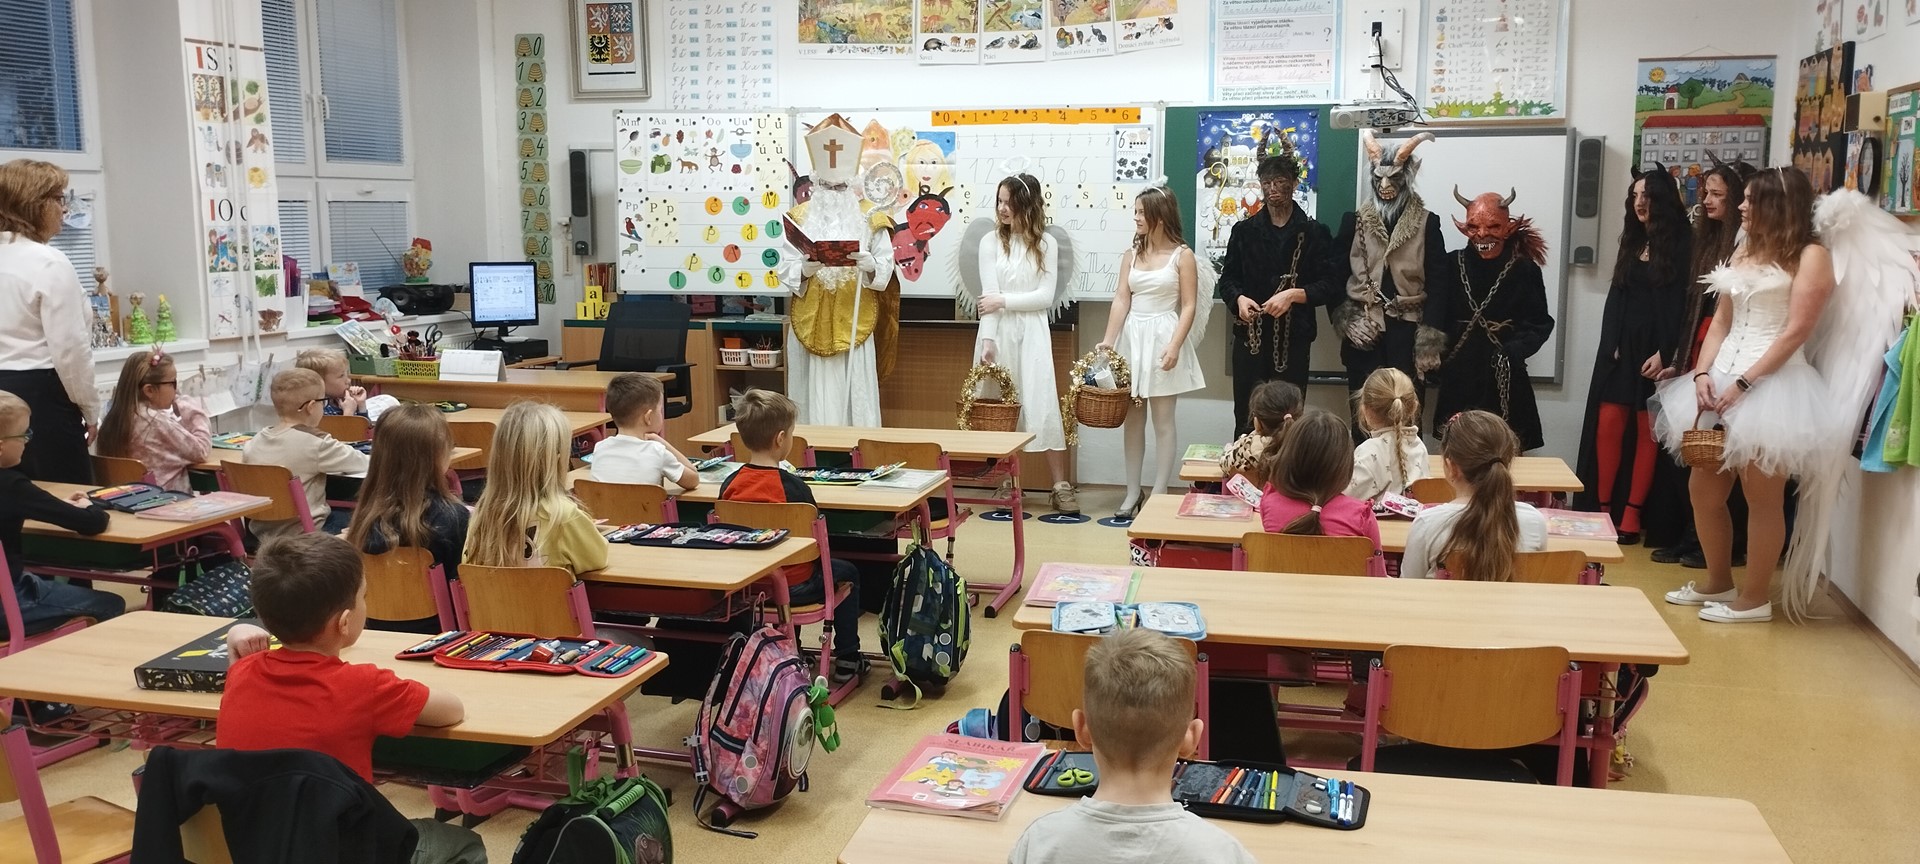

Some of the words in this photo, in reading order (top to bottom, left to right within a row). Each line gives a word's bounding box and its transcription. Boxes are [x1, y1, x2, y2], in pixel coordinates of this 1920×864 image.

[1324, 27, 1332, 42] ?
[533, 37, 541, 56] 0
[206, 47, 218, 71] S
[518, 62, 524, 80] 1
[535, 88, 544, 106] 2
[519, 112, 526, 130] 3
[622, 118, 639, 126] Mm
[682, 118, 692, 126] Ll
[707, 118, 721, 126] Oo
[733, 118, 748, 126] Uu
[758, 118, 767, 128] U
[943, 113, 949, 122] 0
[974, 113, 978, 122] 1
[1002, 112, 1008, 121] 2
[1032, 112, 1038, 120] 3
[1060, 111, 1067, 120] 4
[1091, 110, 1097, 120] 5
[1122, 110, 1129, 120] 6
[993, 137, 998, 148] 2
[1011, 137, 1016, 147] 3
[1049, 137, 1054, 147] 5
[1067, 136, 1070, 146] 6
[1105, 136, 1110, 146] 8
[1118, 130, 1126, 148] 6
[536, 138, 544, 155] 4
[760, 145, 767, 154] ú
[521, 162, 528, 179] 5
[969, 158, 979, 183] 1
[985, 158, 995, 184] 2
[1056, 157, 1065, 183] 6
[1079, 157, 1088, 183] 6
[539, 187, 545, 205] 6
[764, 193, 777, 207] M
[218, 199, 233, 222] O
[626, 202, 638, 211] Pp
[650, 203, 657, 212] P
[667, 205, 674, 215] p
[710, 202, 718, 212] e
[522, 211, 530, 228] 7
[1101, 209, 1107, 230] 6
[772, 222, 778, 235] L
[541, 236, 548, 254] 8
[727, 246, 738, 260] A
[543, 284, 555, 302] 10
[590, 290, 597, 299] a
[600, 305, 606, 317] é
